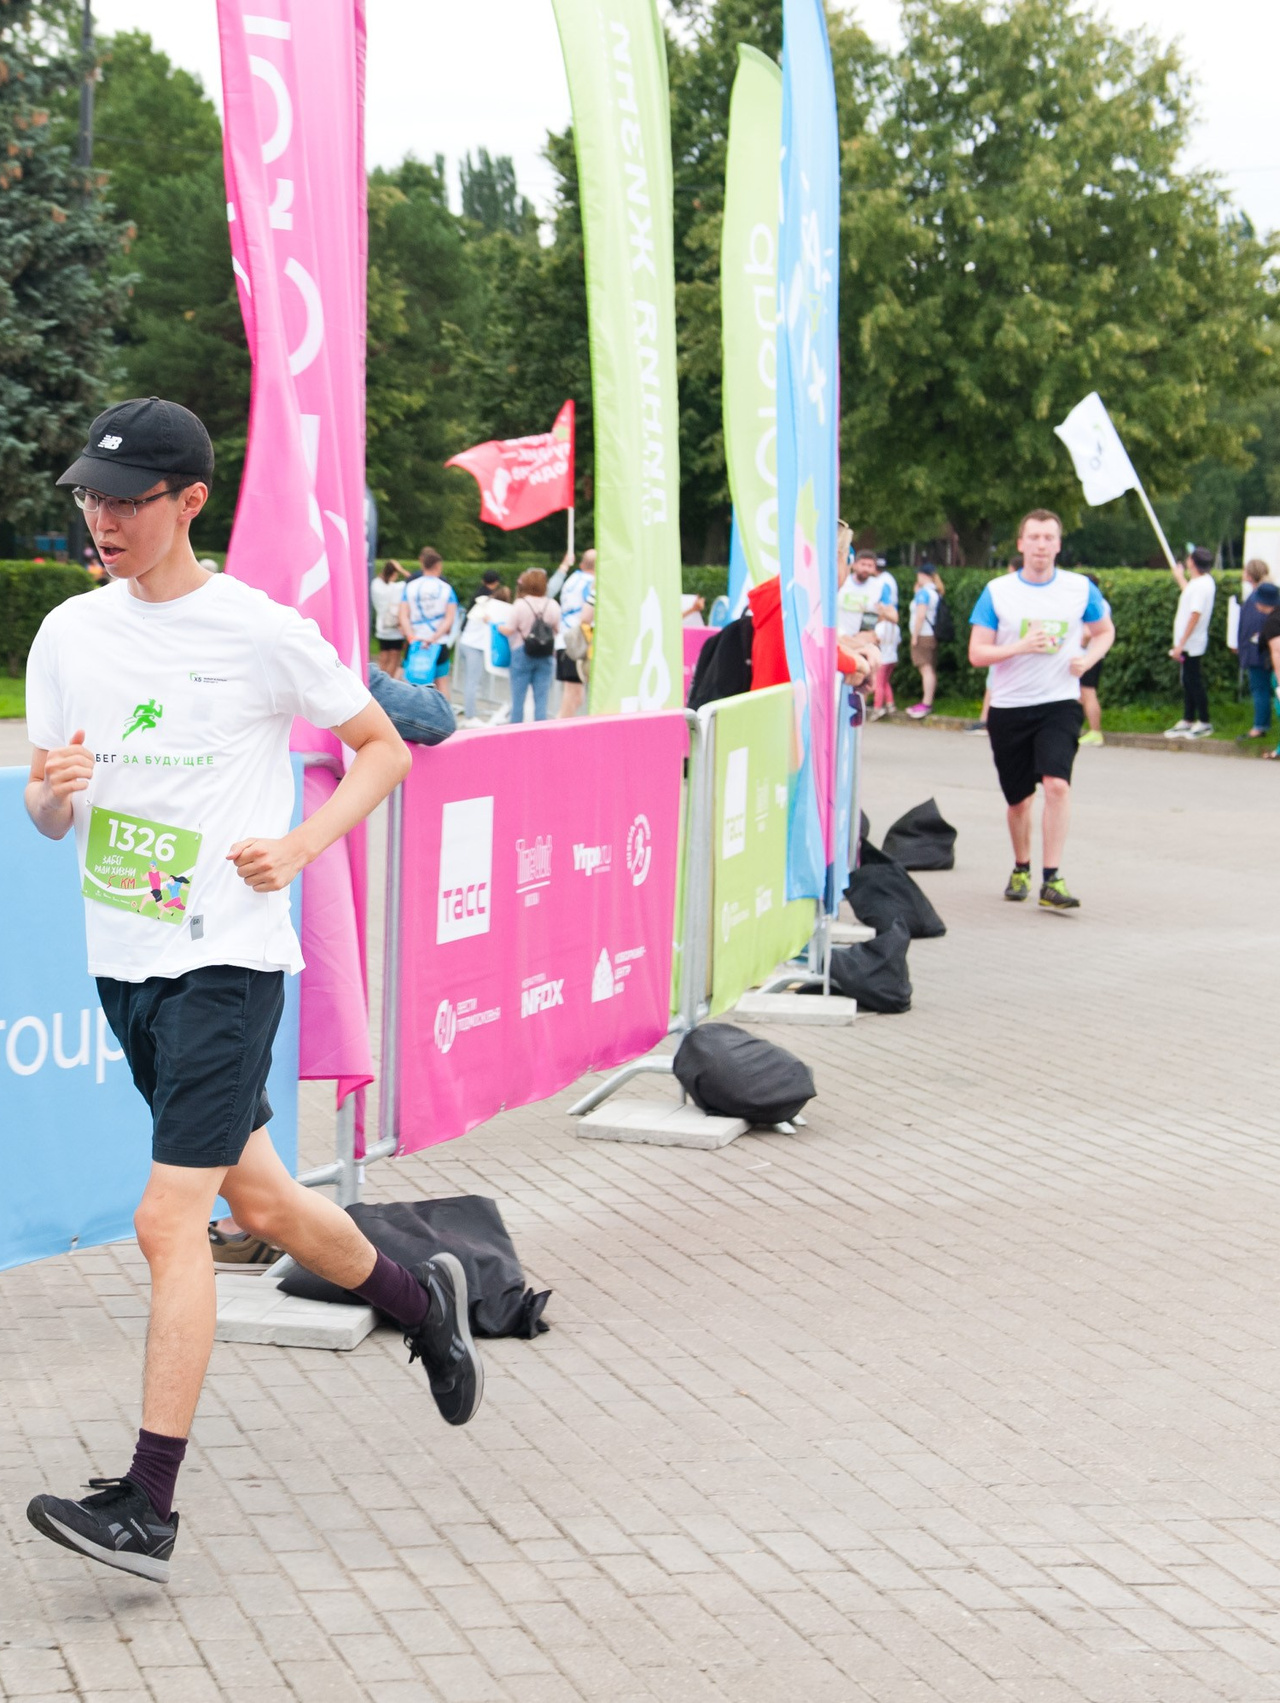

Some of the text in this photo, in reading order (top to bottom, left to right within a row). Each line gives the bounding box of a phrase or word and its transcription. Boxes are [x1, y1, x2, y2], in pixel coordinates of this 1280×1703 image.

[122, 754, 139, 764] ЗА
[145, 755, 214, 767] БУДУЩЕЕ
[108, 818, 178, 862] 1326
[102, 854, 124, 866] ЗАБЕГ
[94, 865, 111, 875] РАДИ
[107, 875, 116, 889] 5
